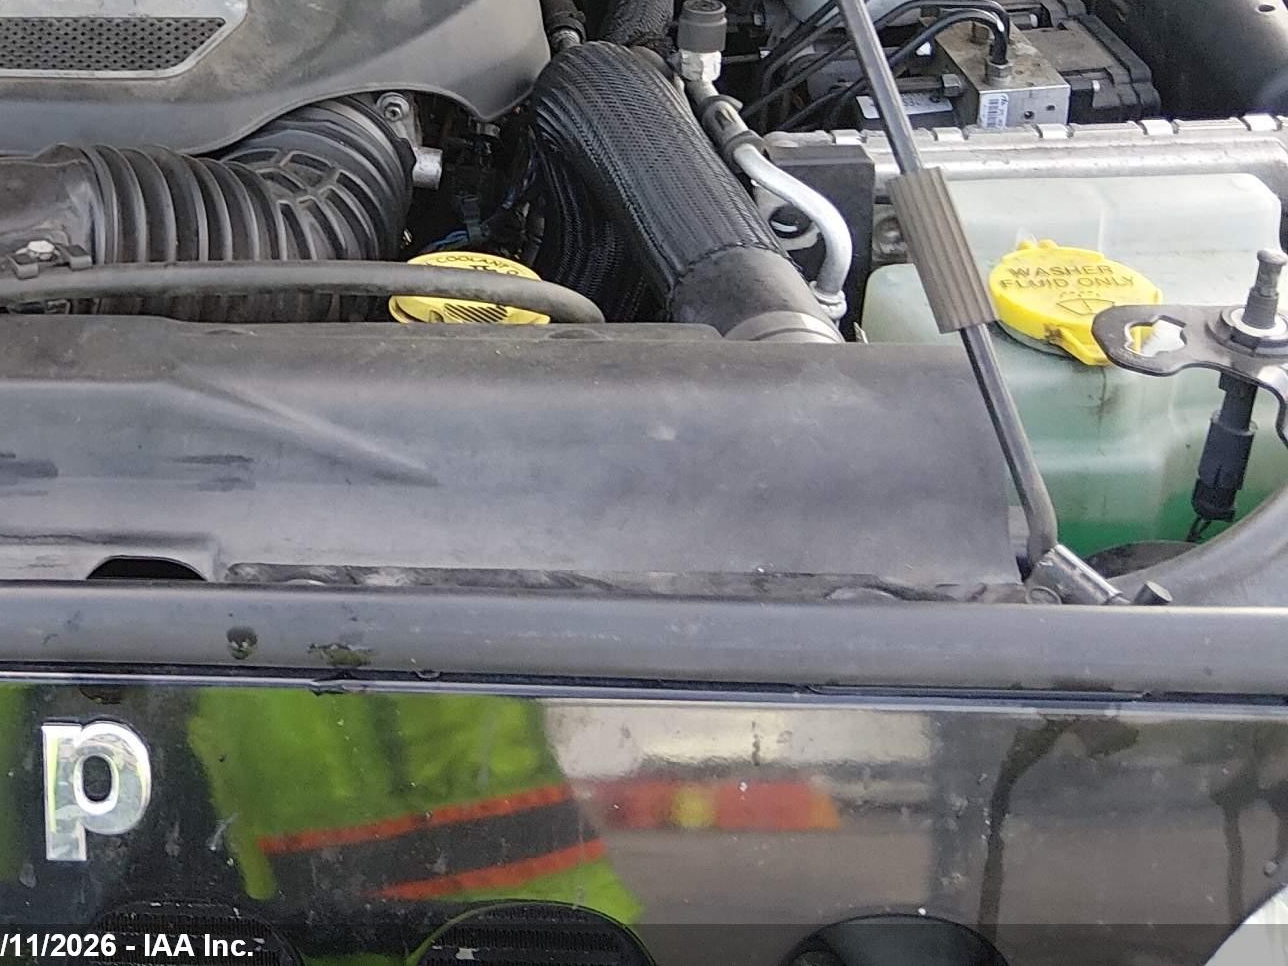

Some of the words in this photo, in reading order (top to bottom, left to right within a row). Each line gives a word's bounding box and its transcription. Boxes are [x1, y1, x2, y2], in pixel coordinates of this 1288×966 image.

[435, 254, 511, 269] COOLANT
[1007, 264, 1114, 278] WASHER
[999, 277, 1069, 291] FLUID
[1076, 275, 1136, 289] ONLY
